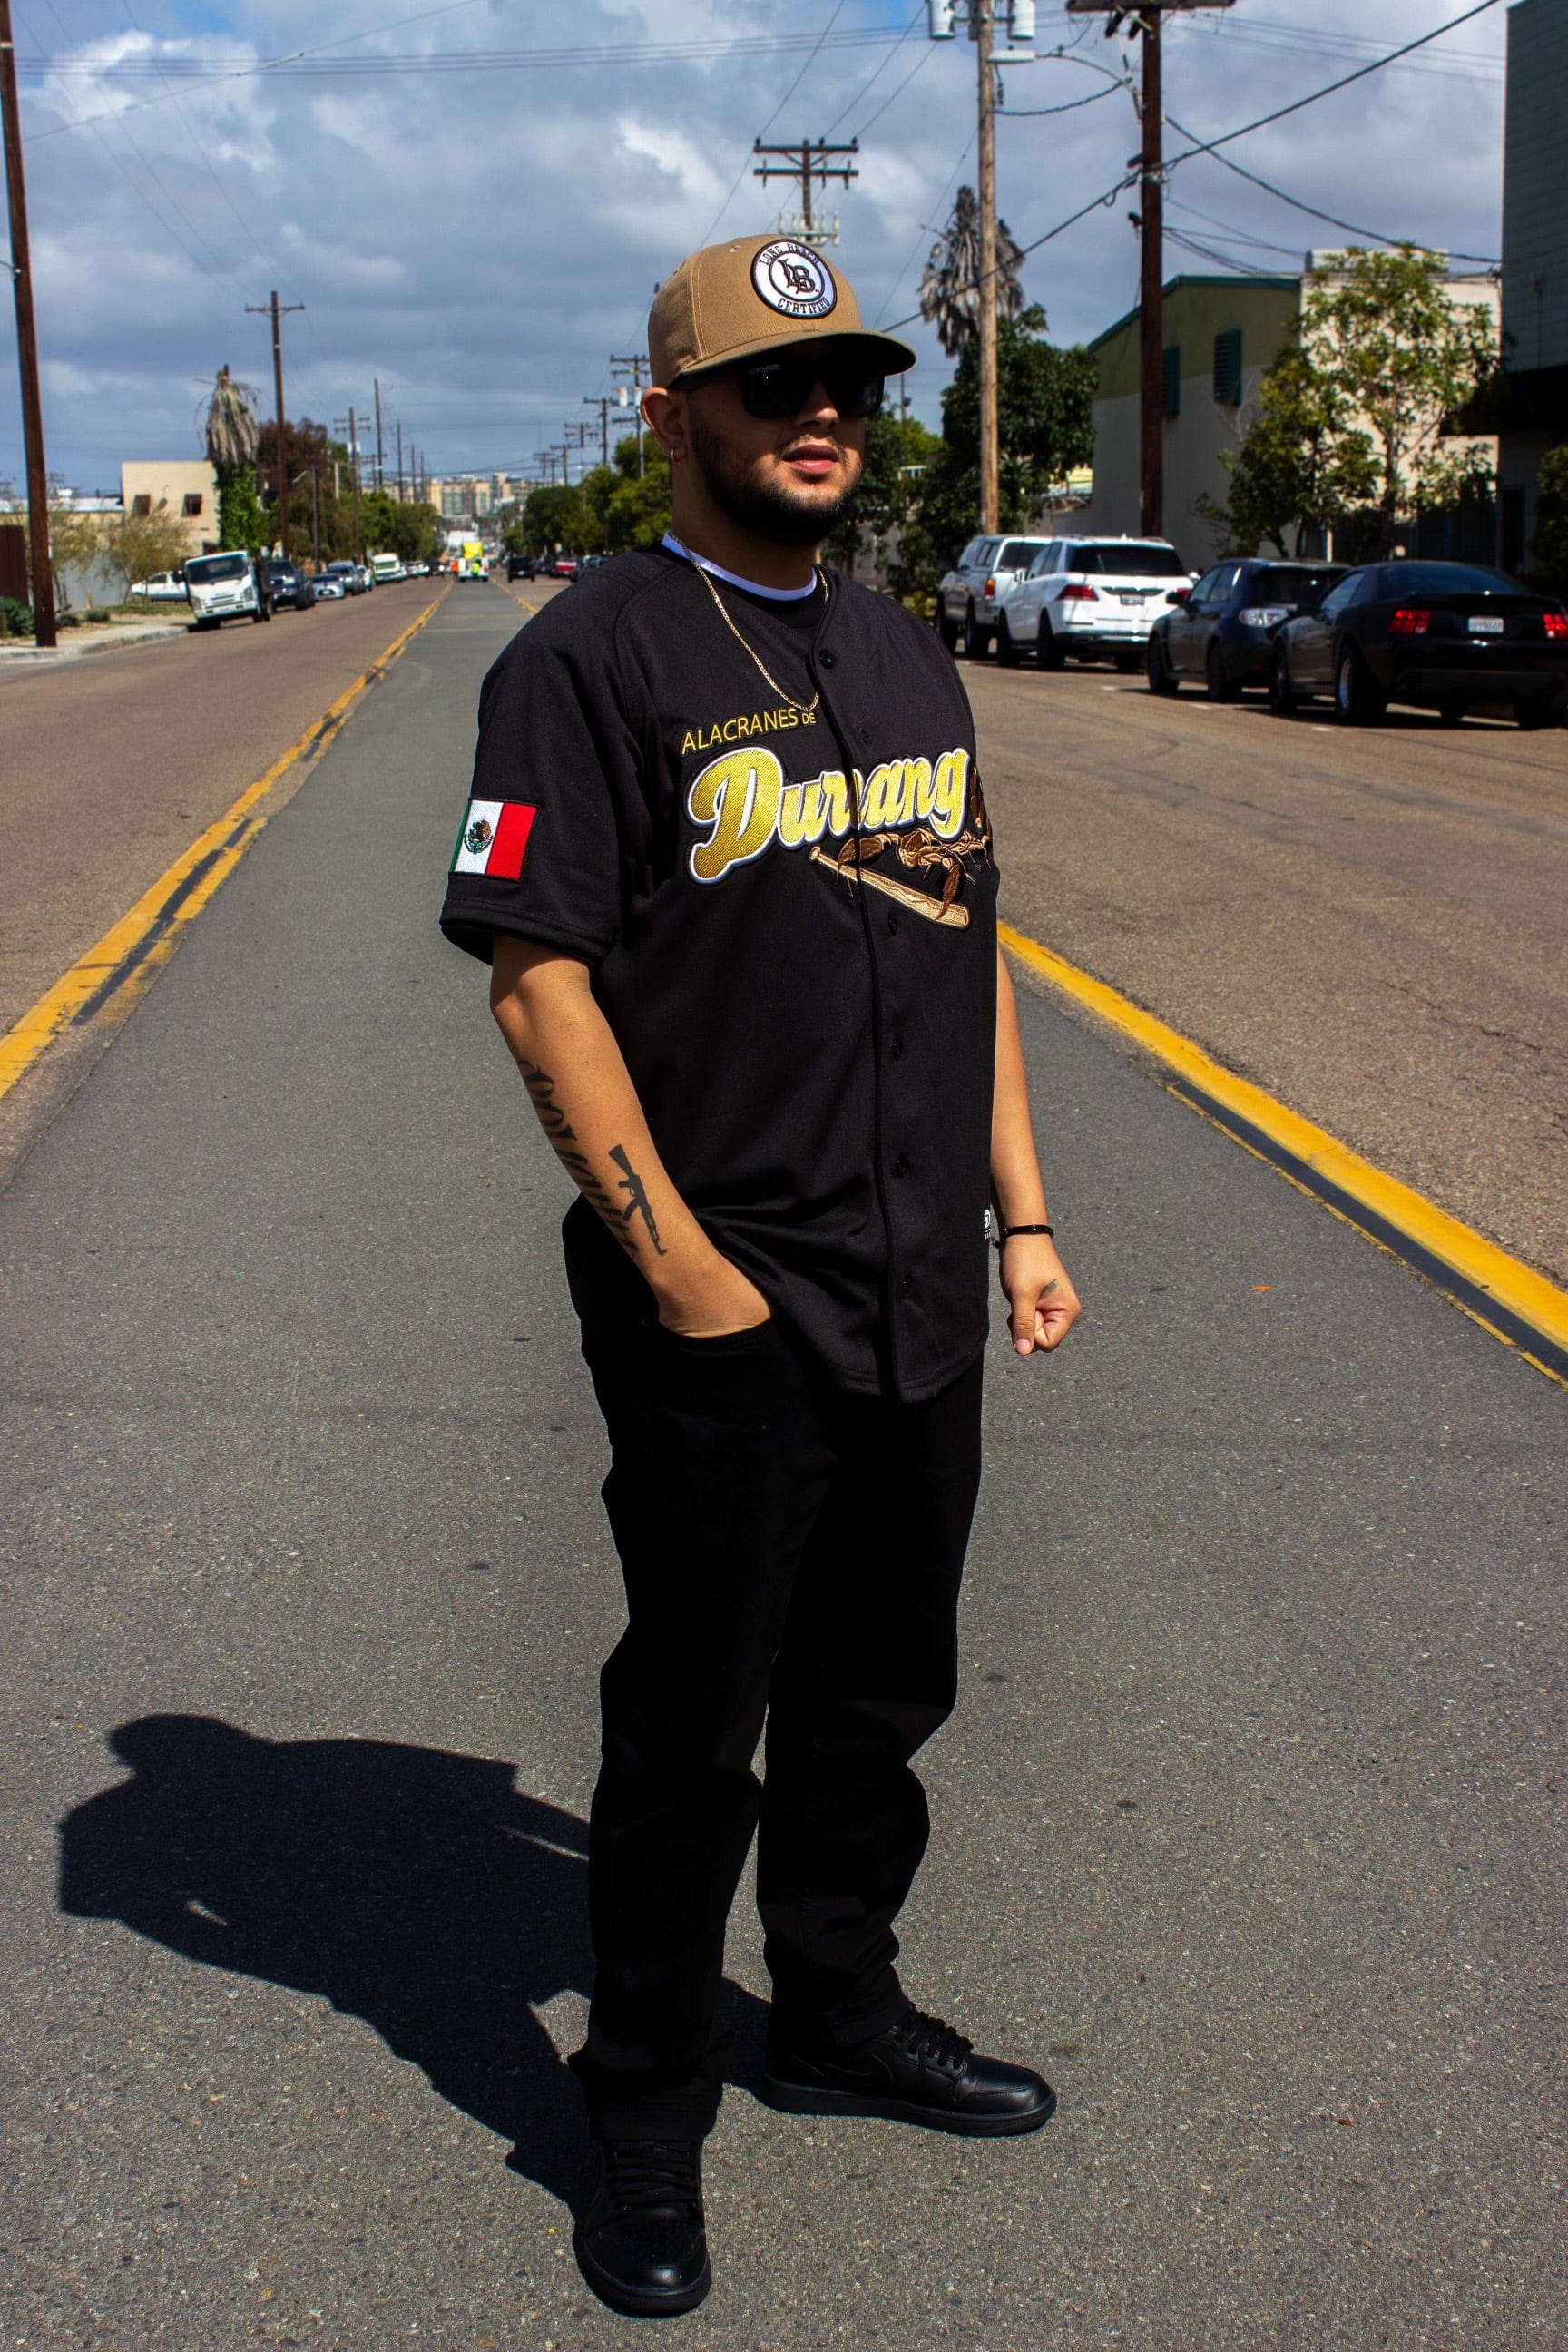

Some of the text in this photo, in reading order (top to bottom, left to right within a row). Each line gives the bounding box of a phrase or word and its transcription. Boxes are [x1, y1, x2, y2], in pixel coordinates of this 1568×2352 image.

[759, 243, 819, 266] LONG BEACH
[778, 297, 831, 314] CERTIFIED
[681, 708, 817, 755] ALACRANES DE
